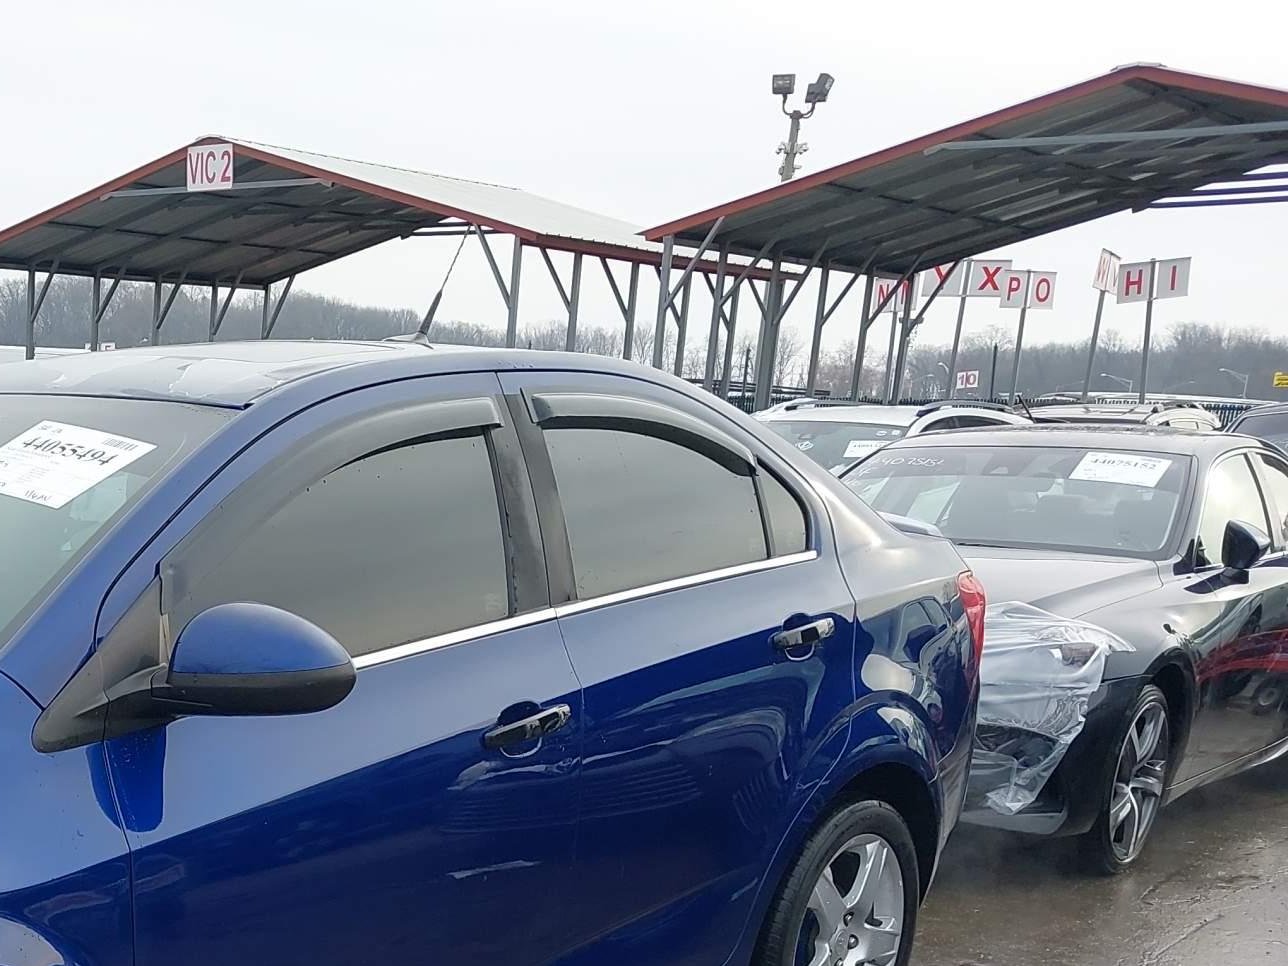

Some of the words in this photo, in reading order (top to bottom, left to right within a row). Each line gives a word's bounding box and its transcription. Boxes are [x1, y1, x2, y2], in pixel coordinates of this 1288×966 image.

[189, 150, 216, 185] VIC
[220, 150, 231, 182] 2
[977, 266, 1002, 291] X
[1006, 276, 1021, 302] P
[1035, 277, 1051, 303] O
[1124, 269, 1143, 296] H
[1170, 265, 1177, 291] I
[958, 373, 977, 386] 10
[23, 436, 119, 466] 44055494
